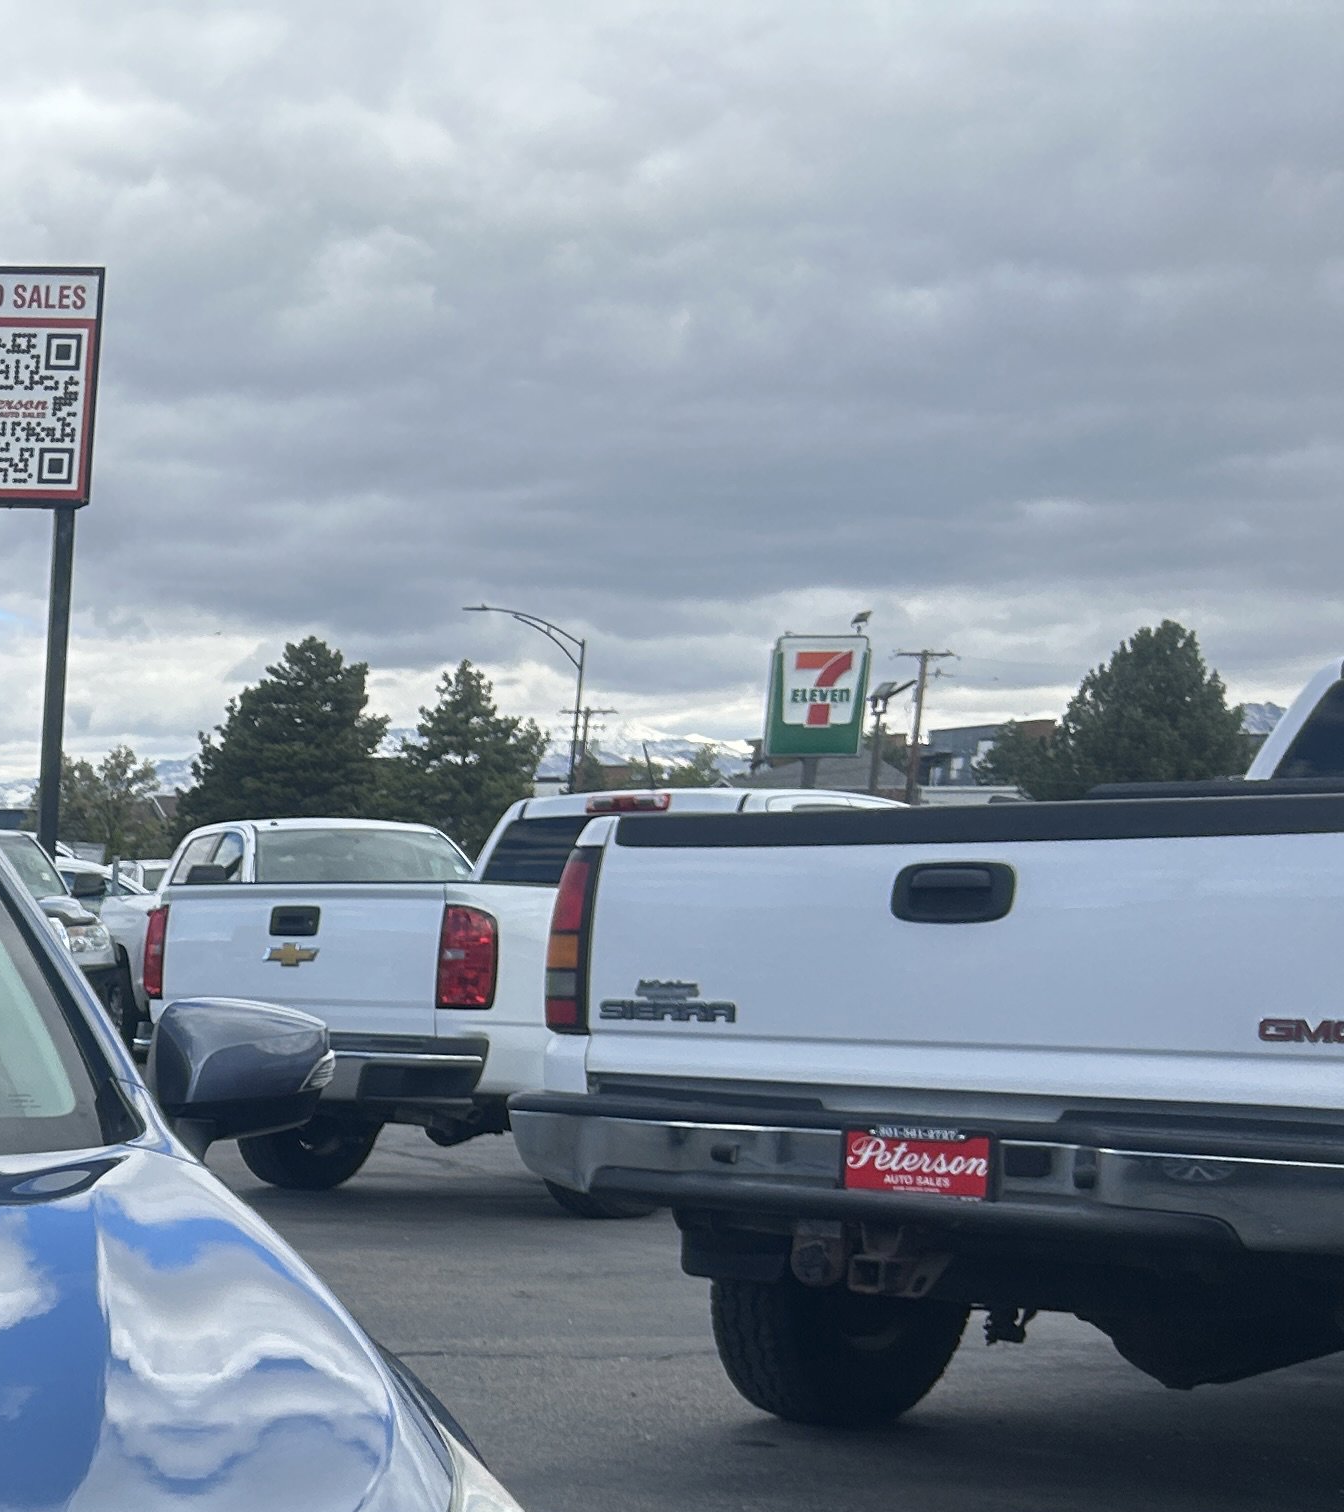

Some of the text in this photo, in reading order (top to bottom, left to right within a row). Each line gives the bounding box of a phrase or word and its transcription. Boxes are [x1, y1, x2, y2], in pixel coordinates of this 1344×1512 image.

[13, 284, 86, 310] SALES
[796, 649, 853, 725] 7
[599, 999, 737, 1023] SIERRA
[847, 1136, 988, 1177] Peterson
[884, 1174, 951, 1188] AUTO SALES
